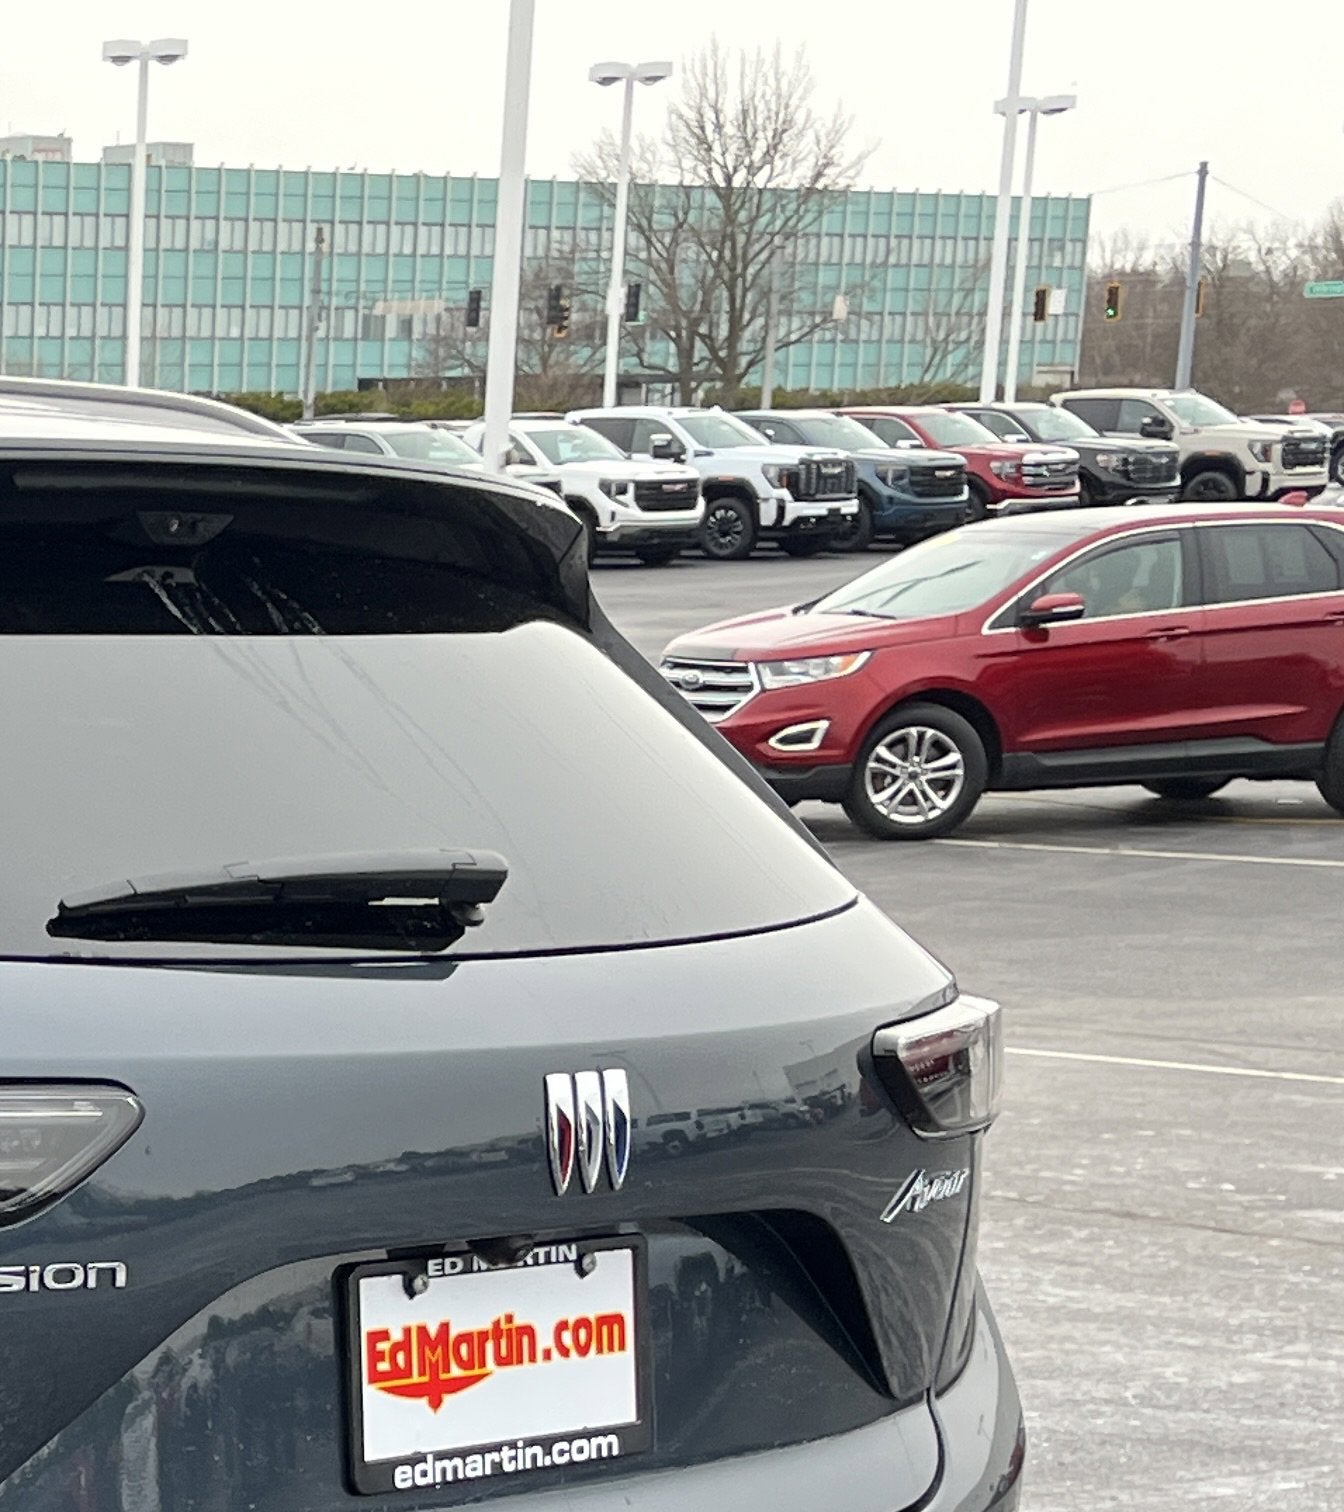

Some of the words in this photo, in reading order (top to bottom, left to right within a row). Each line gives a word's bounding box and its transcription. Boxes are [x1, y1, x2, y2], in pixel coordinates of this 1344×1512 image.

[427, 1257, 464, 1277] ED
[366, 1312, 626, 1385] EdMartin.com
[394, 1433, 620, 1489] edmartin.com
